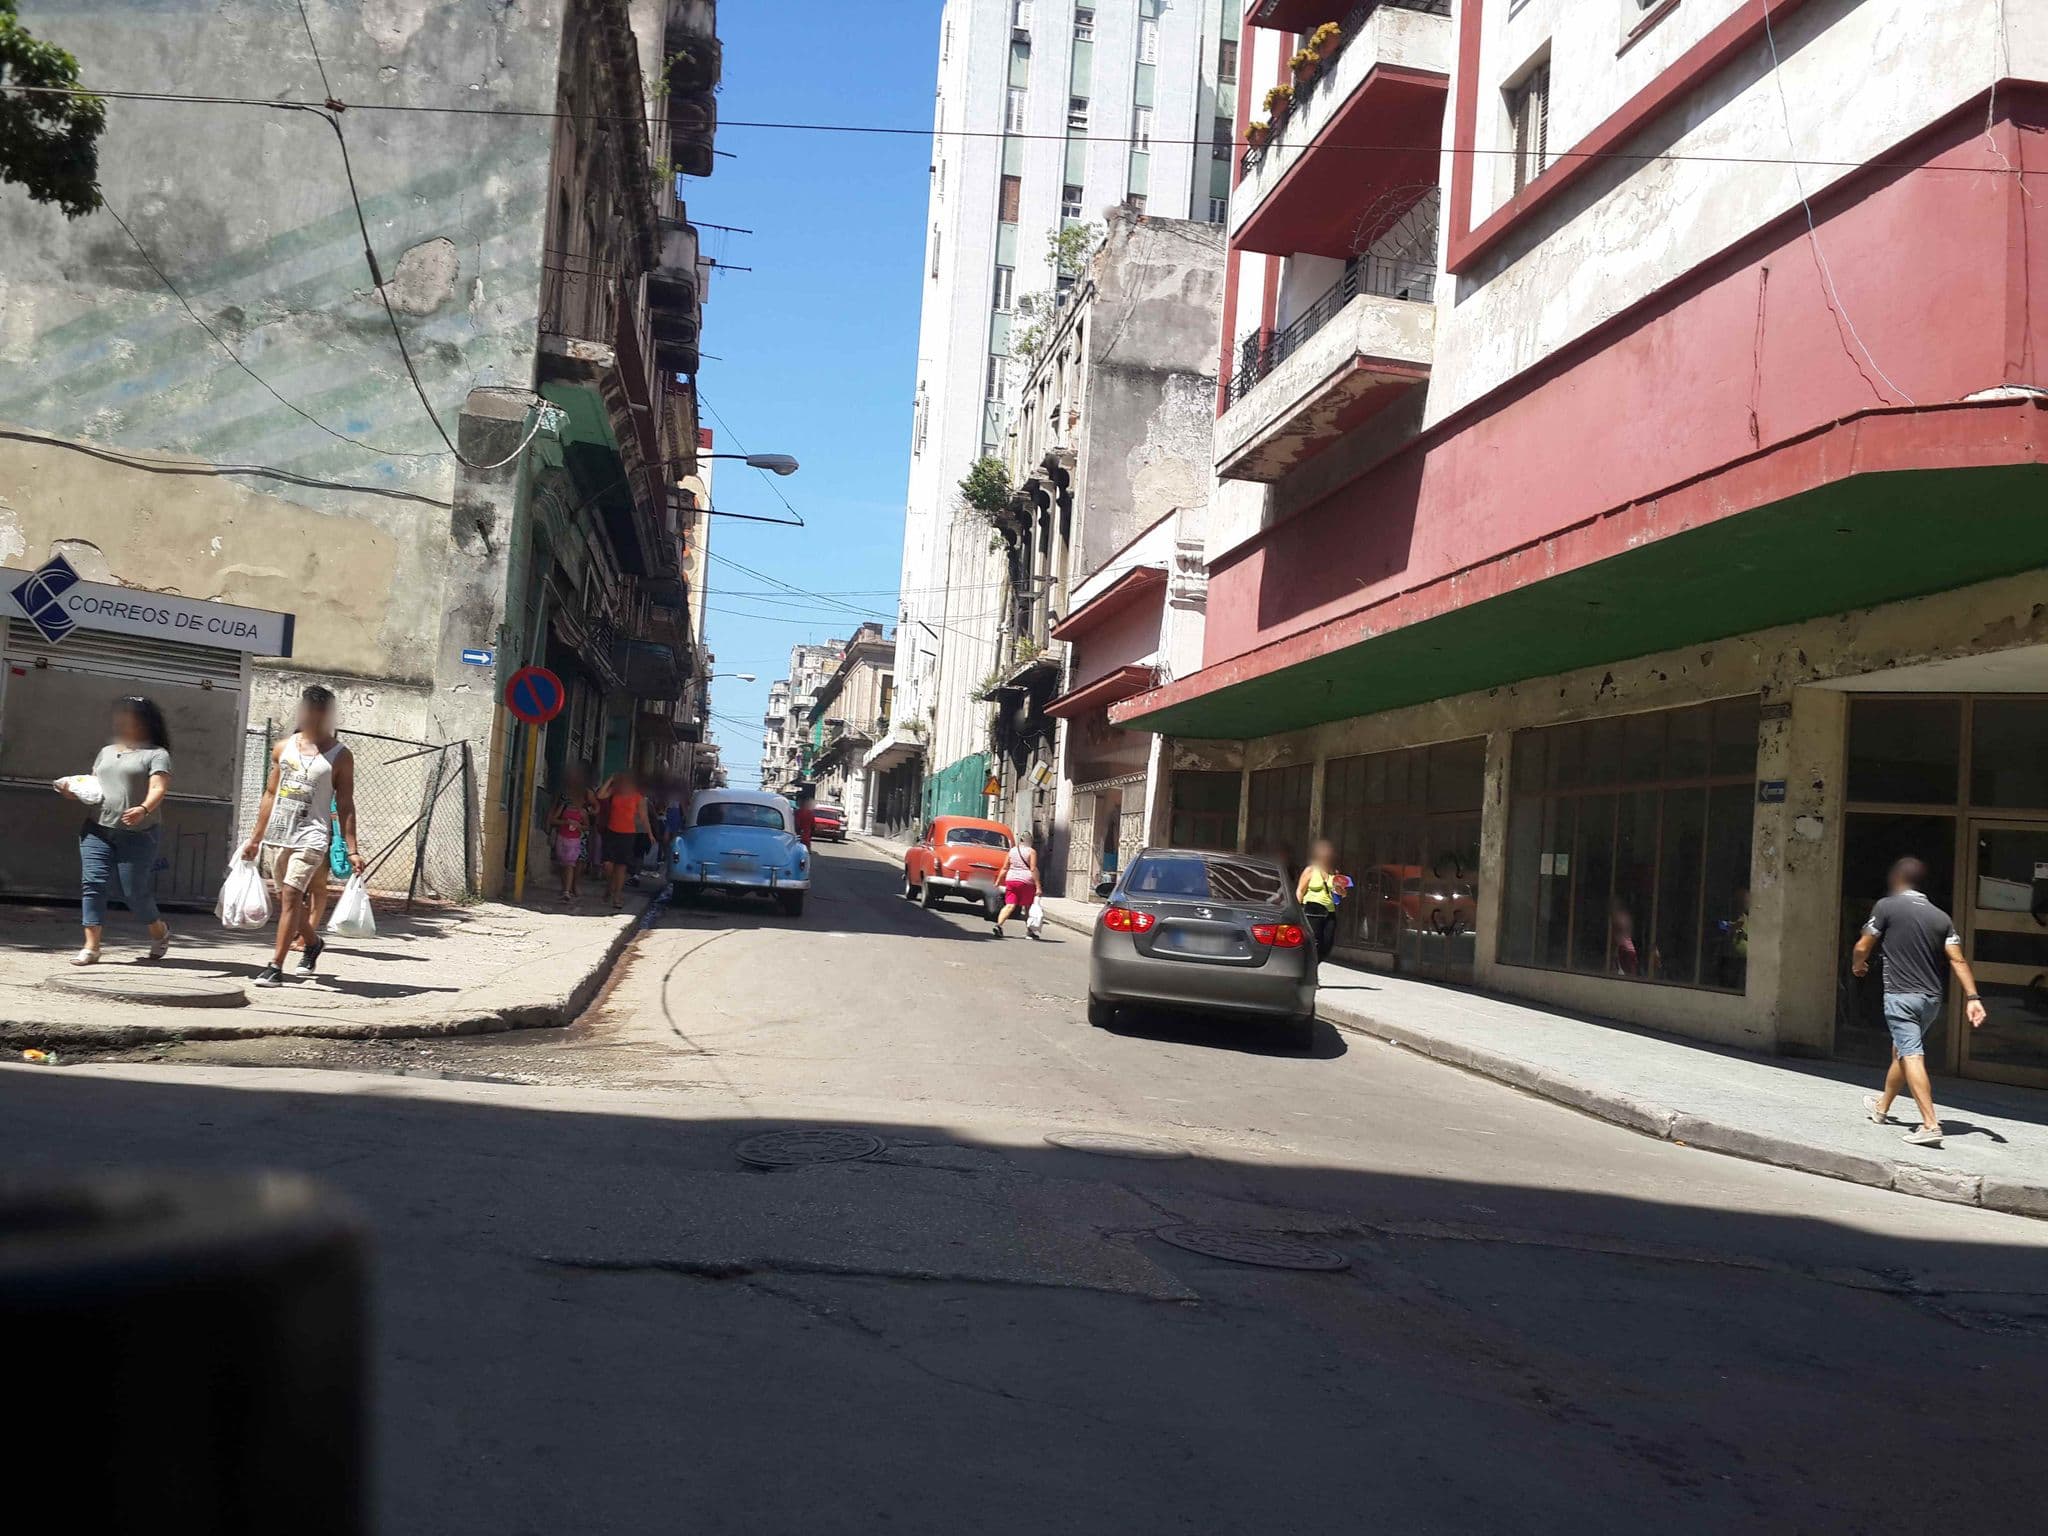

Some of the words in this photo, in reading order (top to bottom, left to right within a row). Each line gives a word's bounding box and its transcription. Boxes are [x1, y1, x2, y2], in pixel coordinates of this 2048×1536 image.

[68, 595, 170, 625] CORREOS
[175, 612, 204, 630] DE
[207, 618, 258, 639] CUBA
